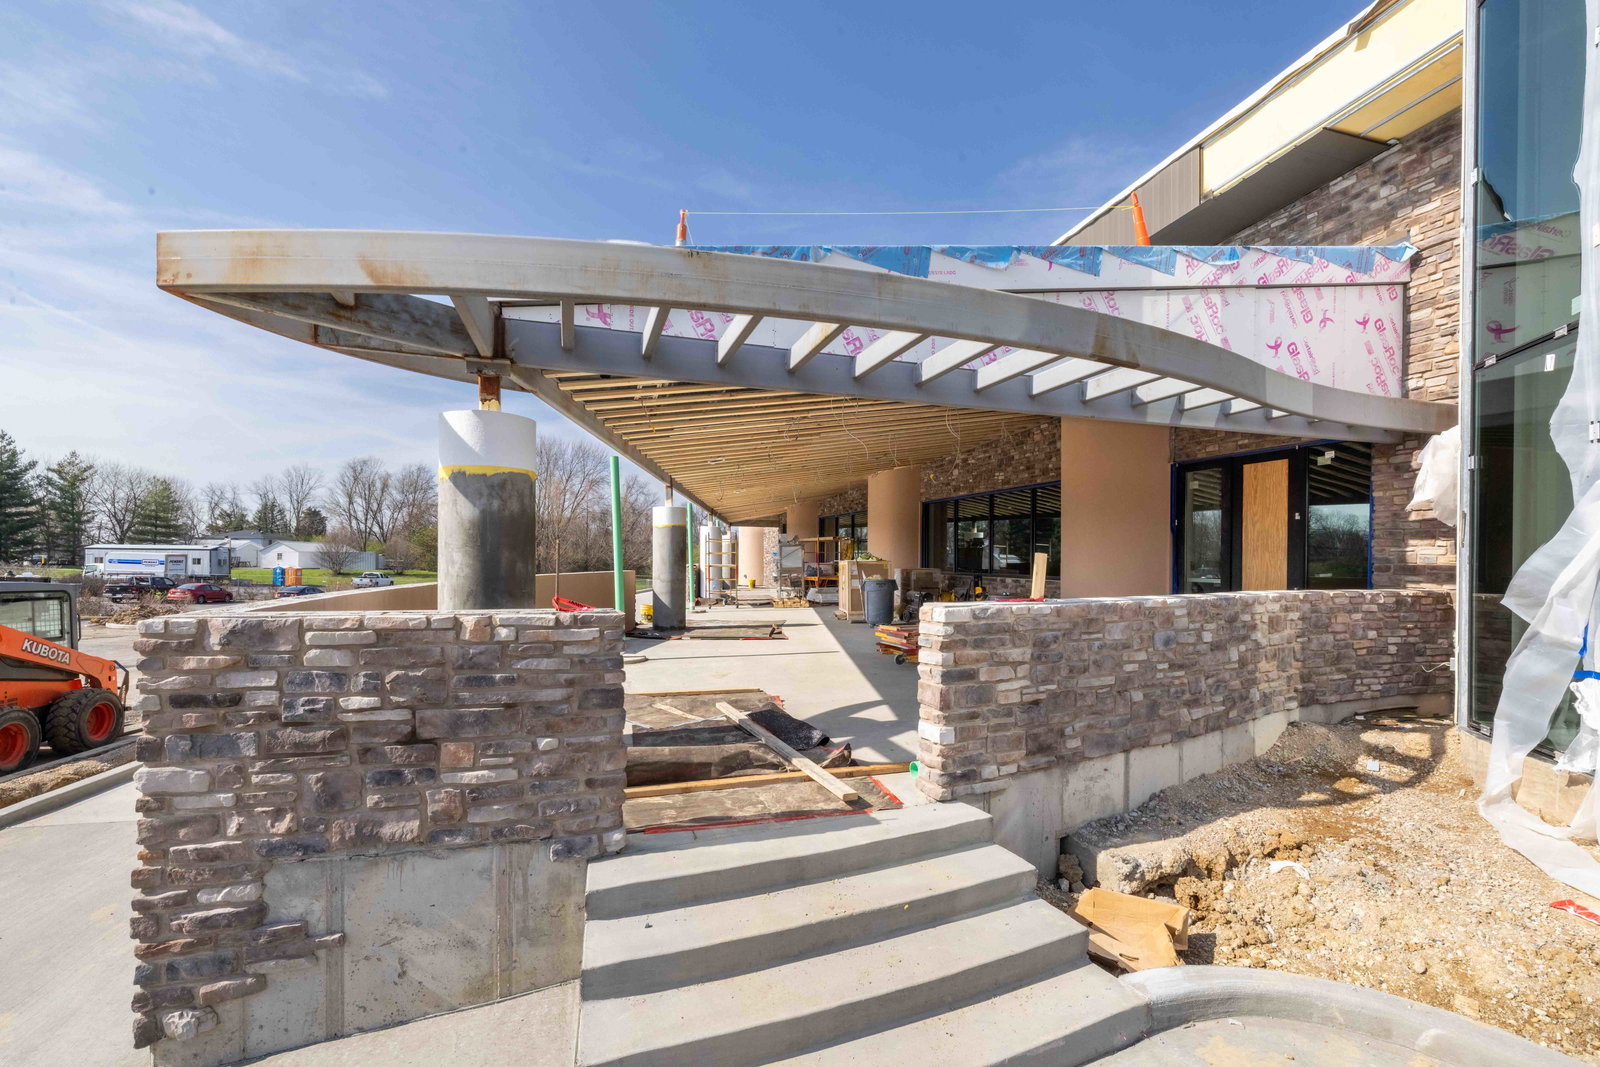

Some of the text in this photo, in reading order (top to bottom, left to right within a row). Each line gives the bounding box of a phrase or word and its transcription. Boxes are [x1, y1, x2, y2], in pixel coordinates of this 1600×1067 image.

[1286, 341, 1310, 381] GlasR
[1373, 317, 1400, 375] GlasRoc
[22, 638, 70, 664] KUBOTA
